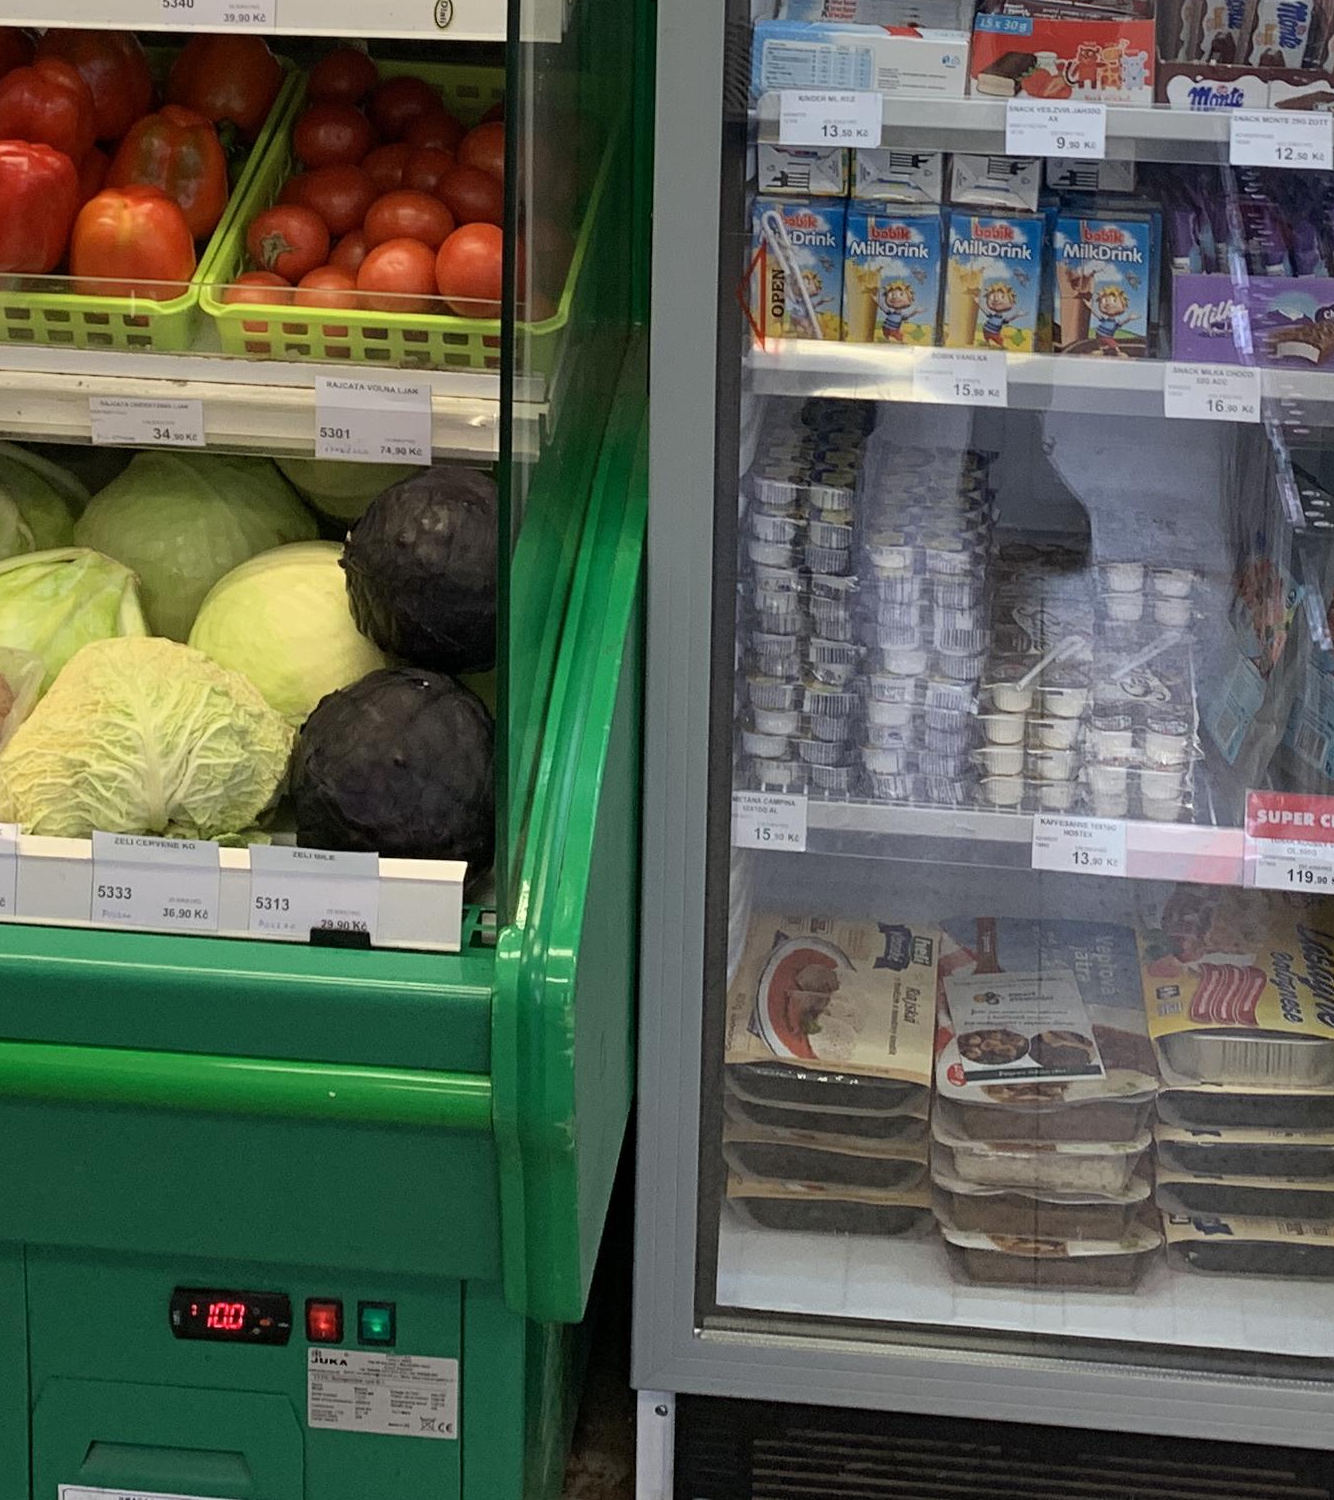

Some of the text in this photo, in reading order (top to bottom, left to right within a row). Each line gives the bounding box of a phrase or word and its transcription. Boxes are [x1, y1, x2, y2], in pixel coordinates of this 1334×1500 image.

[1276, 0, 1309, 51] Monte
[1187, 85, 1245, 109] Monte
[869, 223, 911, 241] bobik
[972, 223, 1015, 242] bobik
[1082, 226, 1125, 245] bobik
[849, 241, 929, 260] MilkDrink
[952, 240, 1032, 261] MilkDrink
[1063, 244, 1143, 264] MilkDrink
[770, 267, 785, 319] OPEN
[319, 426, 351, 440] 5301
[1257, 810, 1313, 826] SUPER
[97, 885, 132, 900] 5333
[255, 897, 290, 911] 5313
[310, 1355, 349, 1367] JUKA
